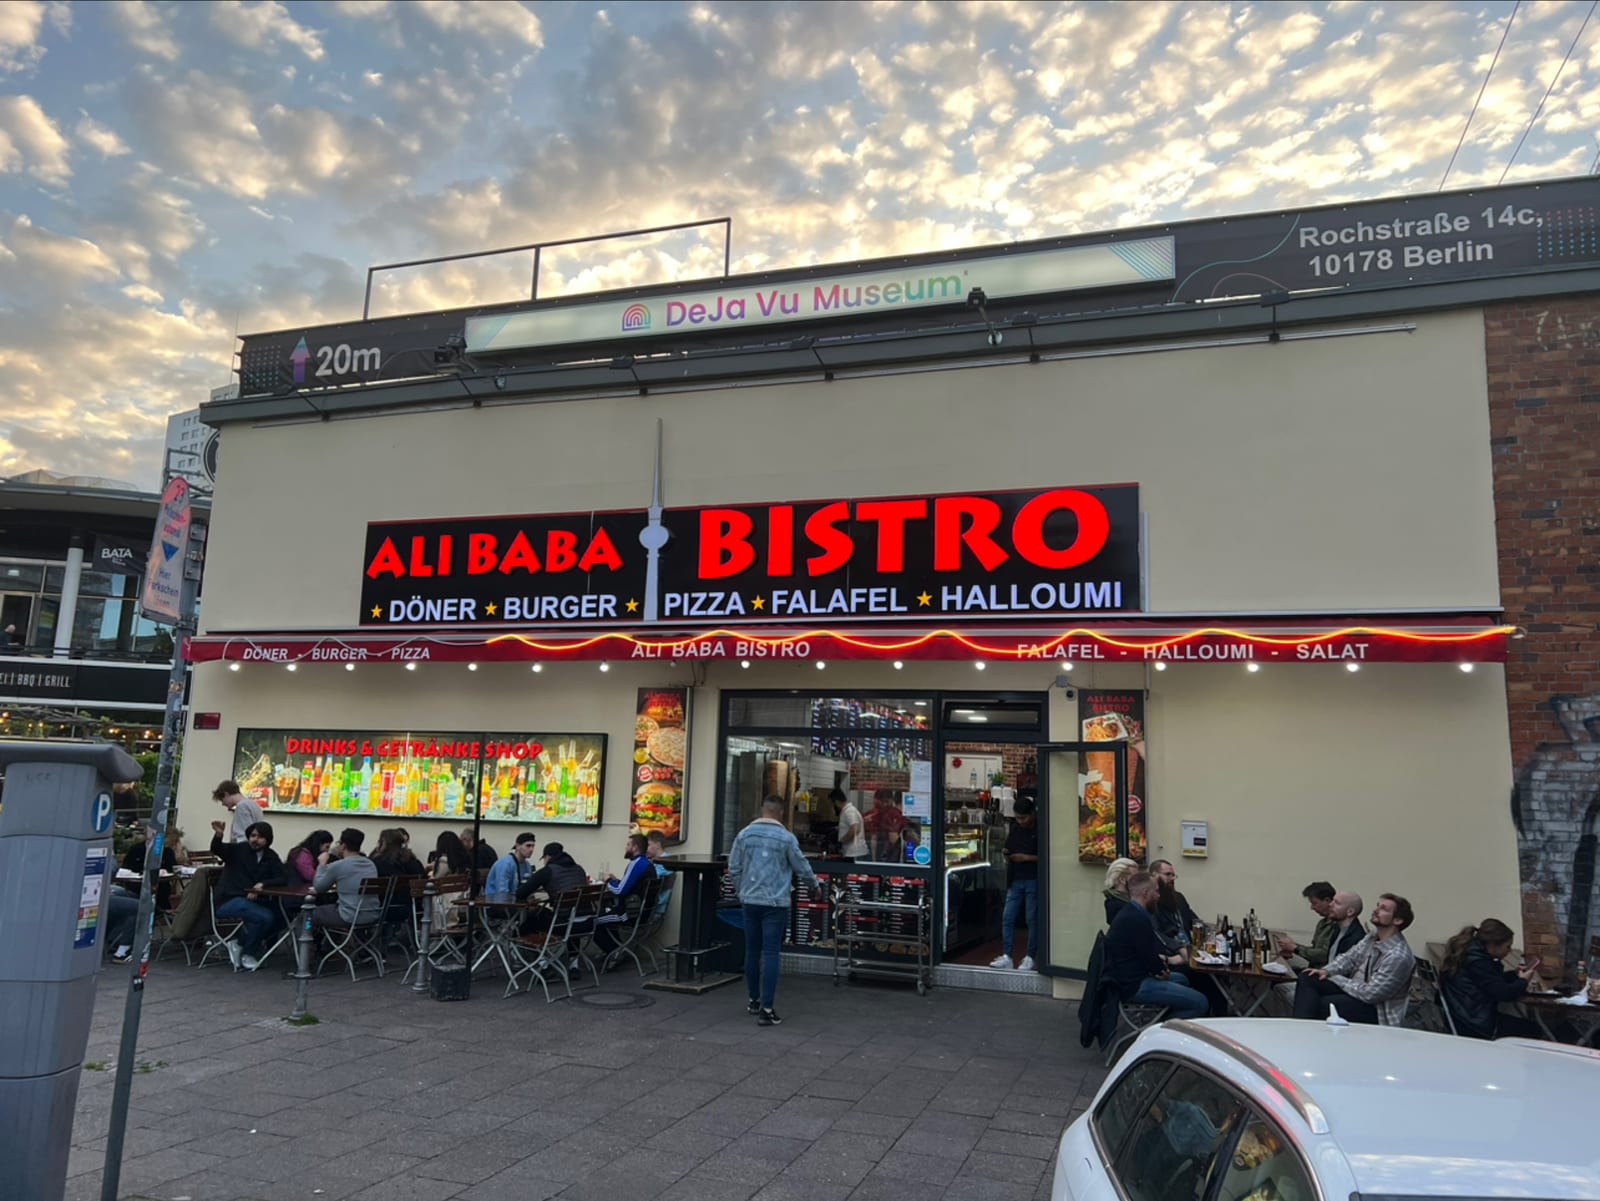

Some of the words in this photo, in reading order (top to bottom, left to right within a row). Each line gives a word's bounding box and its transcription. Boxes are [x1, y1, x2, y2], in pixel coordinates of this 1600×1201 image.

[1299, 212, 1471, 248] Rochstraße
[1481, 204, 1543, 228] 14c,
[1308, 249, 1393, 277] 10178
[1403, 240, 1493, 268] Berlin
[666, 296, 746, 327] DeJa
[755, 290, 800, 316] Vu
[813, 275, 961, 311] Museum
[315, 344, 382, 377] 20m
[697, 488, 1110, 579] BISTRO
[101, 547, 133, 559] BATA
[366, 534, 453, 580] ALI
[467, 526, 624, 575] BABA
[388, 595, 477, 622] DÖNER
[503, 594, 618, 620] BURGER
[664, 591, 746, 617] PIZZA
[771, 587, 908, 615] FALAFEL
[941, 581, 1122, 611] HALLOUMI
[242, 645, 289, 661] DÖNER
[311, 647, 368, 660] BURGER
[391, 647, 431, 660] PIZZA
[631, 643, 662, 658] ALI
[672, 641, 726, 658] BABA
[735, 641, 811, 658] BISTRO
[1017, 643, 1105, 659] FALAFEL
[1143, 644, 1254, 660] HALLOUMI
[1296, 643, 1369, 660] SALAT
[44, 674, 71, 688] GRILL
[285, 738, 358, 756] DRINKS
[361, 739, 373, 756] &
[376, 737, 480, 759] GETRÄNKE
[485, 741, 544, 760] SHOP
